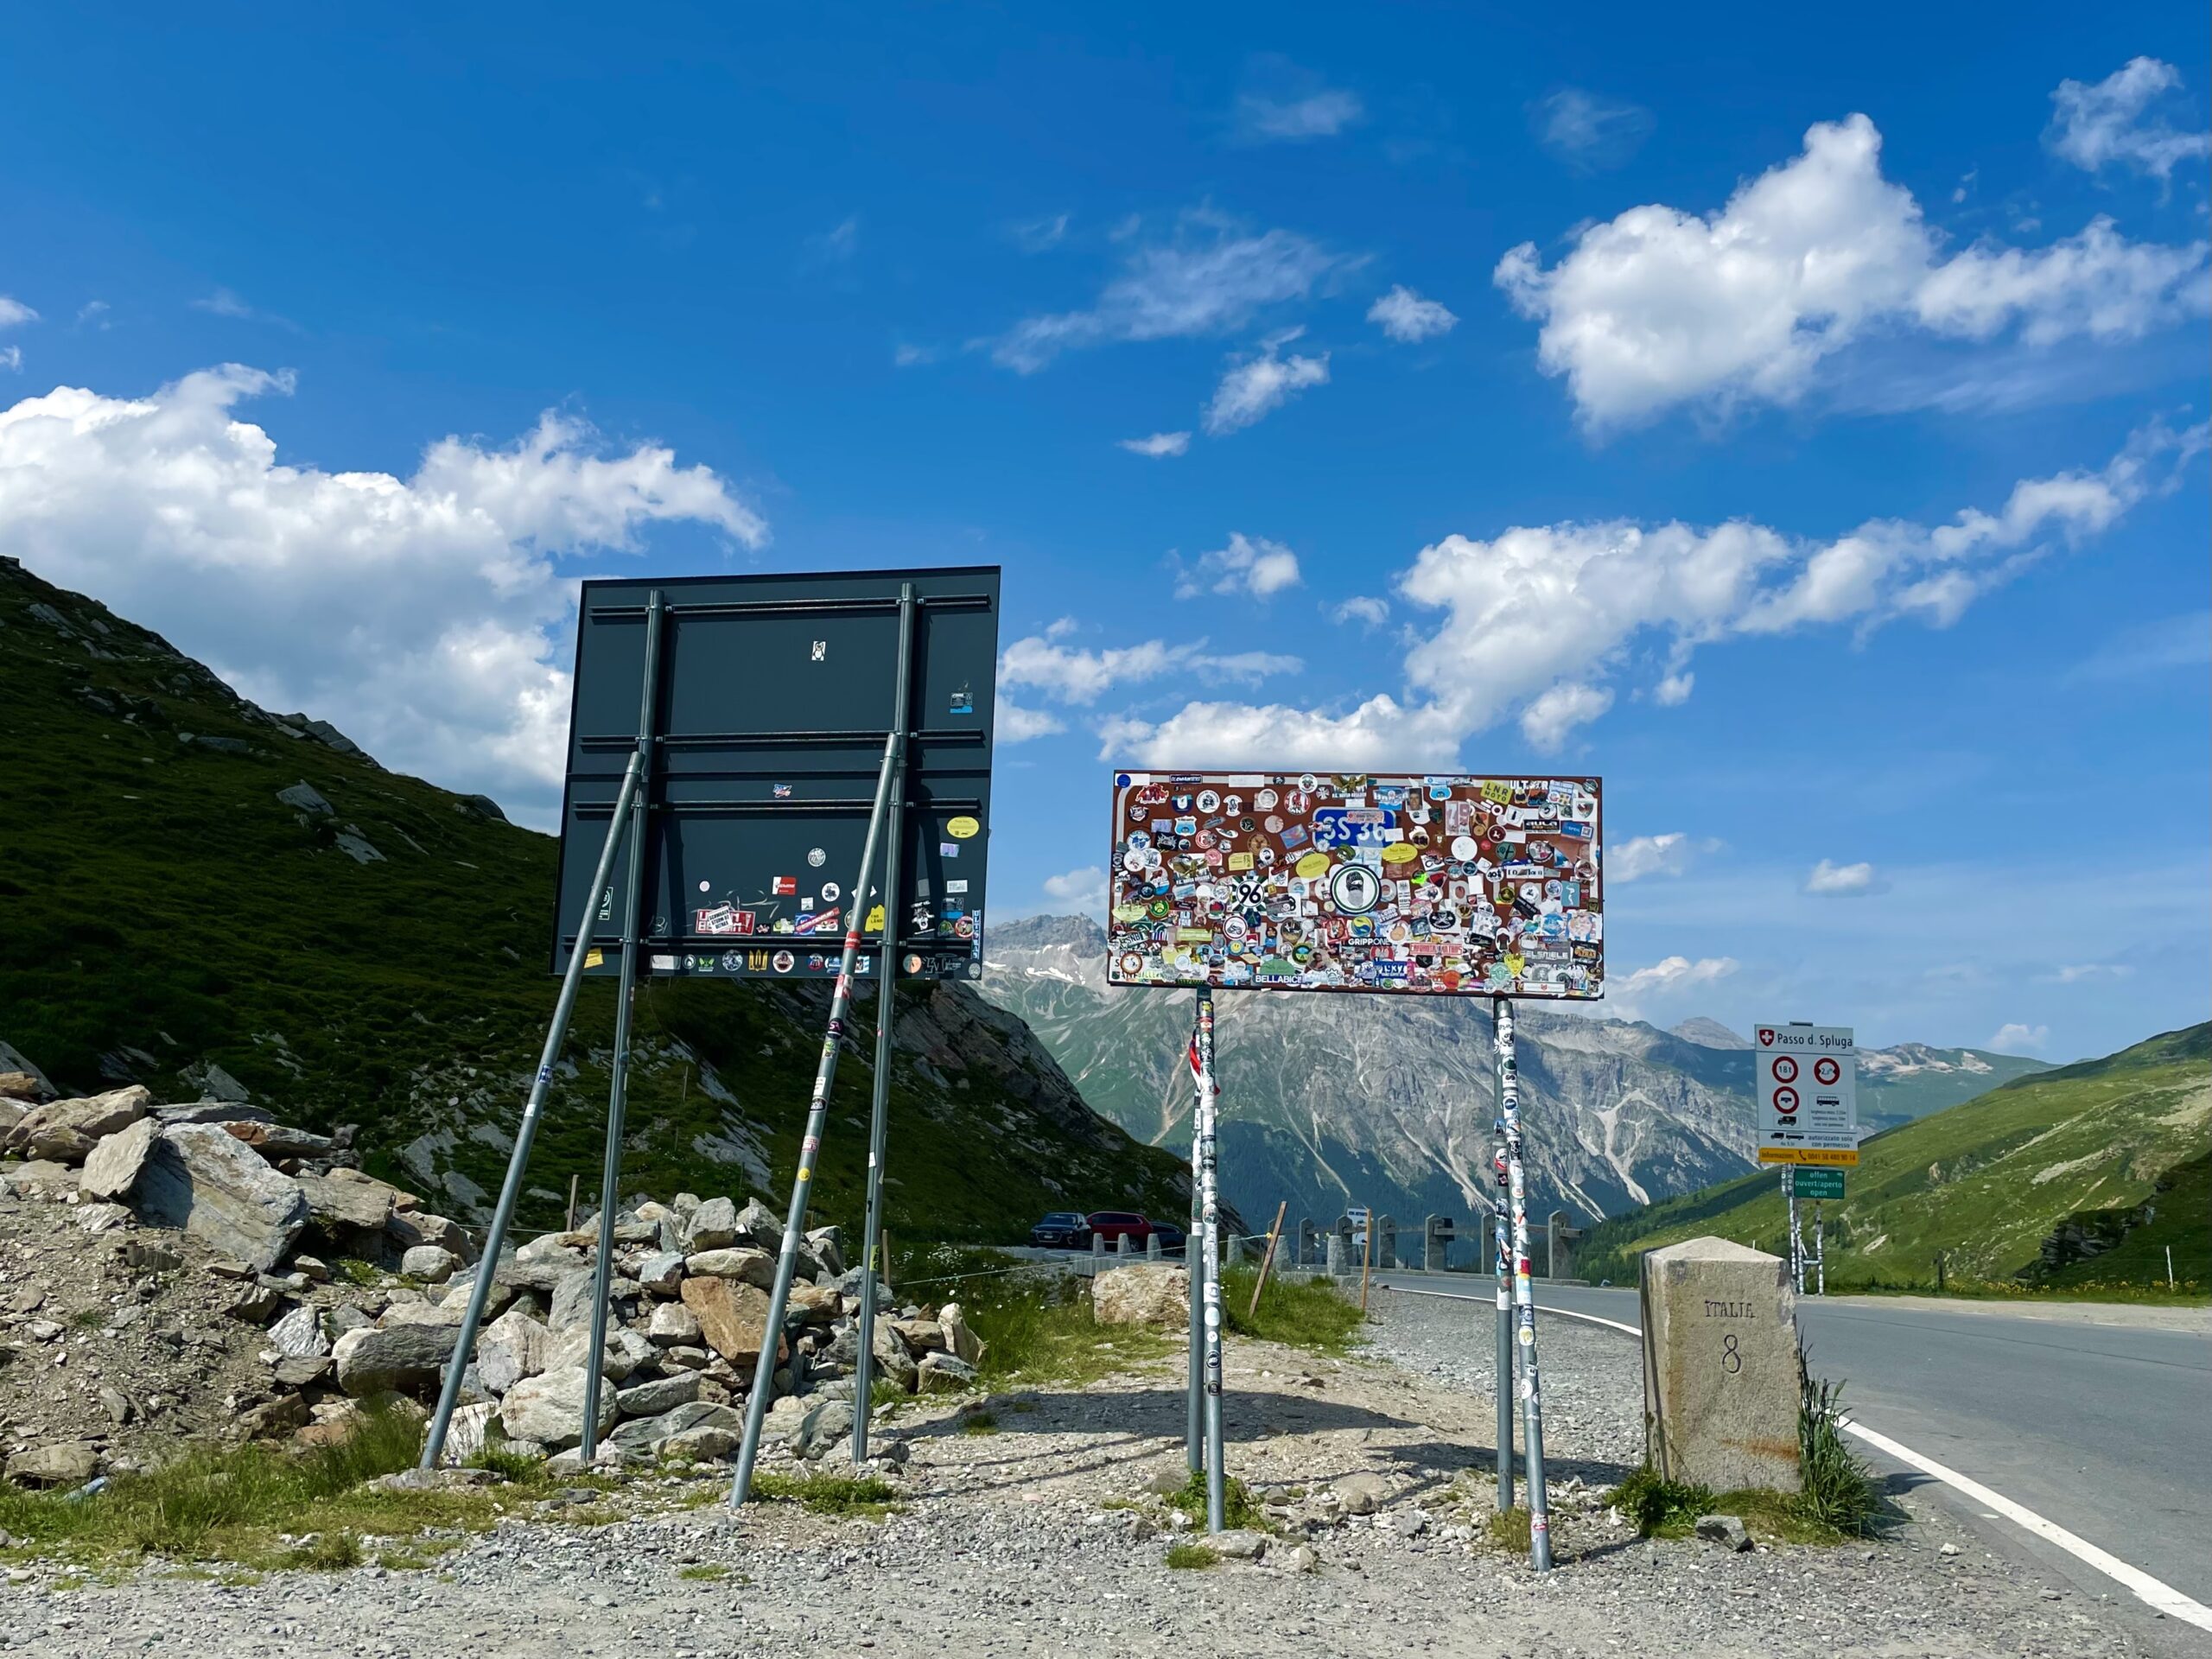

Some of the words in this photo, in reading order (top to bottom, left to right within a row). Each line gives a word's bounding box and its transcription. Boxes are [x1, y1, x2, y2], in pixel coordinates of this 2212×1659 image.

[1484, 790, 1507, 802] MOTO
[1486, 782, 1509, 796] LNR
[1323, 816, 1351, 840] SS
[1357, 822, 1385, 841] 36
[1239, 884, 1262, 904] 96
[1777, 1033, 1804, 1045] Passo
[1808, 1034, 1816, 1046] d.
[1820, 1035, 1853, 1049] Spluga
[1795, 1179, 1842, 1188] ouvert/aperto
[1721, 1334, 1741, 1374] 8
